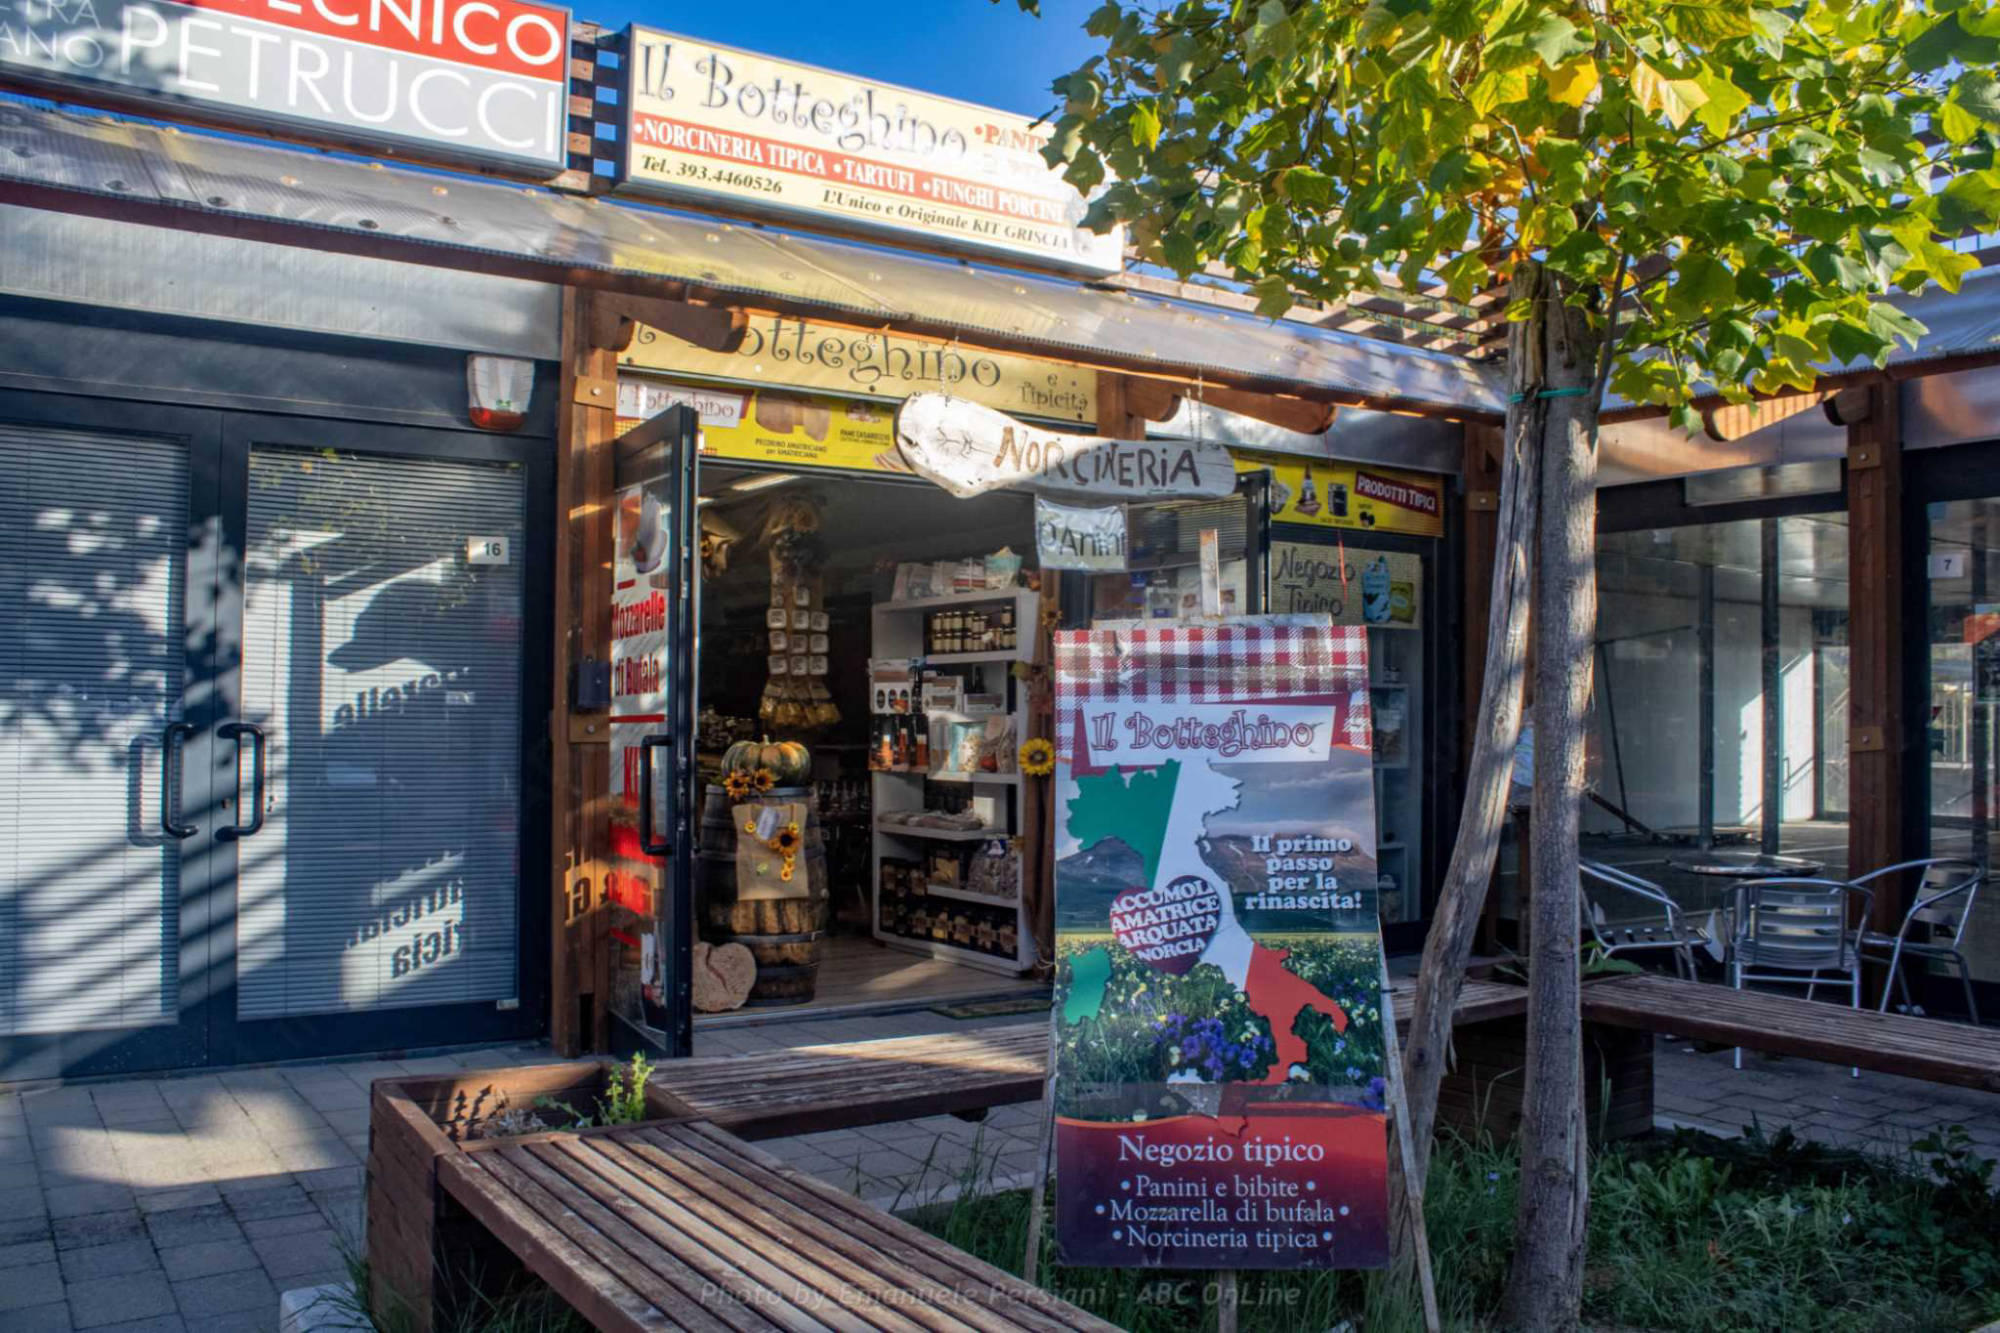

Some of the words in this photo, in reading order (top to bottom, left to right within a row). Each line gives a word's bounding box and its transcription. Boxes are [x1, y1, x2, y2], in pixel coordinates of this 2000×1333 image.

[119, 4, 558, 154] PETRUCCI
[638, 43, 676, 102] Il
[694, 53, 967, 158] Botteghino
[642, 117, 764, 163] NORCINERIA
[767, 143, 827, 175] TIPICA
[843, 159, 916, 193] TARTUFI
[931, 176, 995, 209] FUNGHI
[997, 189, 1066, 223] PORCINI
[642, 155, 671, 175] Tel.
[676, 161, 783, 194] 393.4460526
[898, 204, 968, 229] Originale
[972, 219, 1001, 235] KIT
[689, 318, 1000, 387] otteghino
[1356, 474, 1407, 503] PRODOTTI
[1408, 487, 1436, 512] TIPICI
[482, 542, 502, 557] 16
[1943, 559, 1953, 571] 7
[1091, 711, 1117, 751] Il
[1124, 709, 1315, 757] Botteghino
[1250, 836, 1272, 853] Il
[1275, 836, 1353, 861] primo
[1266, 857, 1335, 877] passo
[1268, 877, 1310, 896] per
[1315, 872, 1339, 890] la
[1112, 894, 1220, 932] AMATRICE
[1245, 892, 1362, 911] rinascita!
[1119, 914, 1218, 949] ARQUATA
[1136, 936, 1206, 962] NORCIA
[1118, 1134, 1233, 1167] Negozio
[1242, 1135, 1325, 1167] tipico
[1135, 1174, 1208, 1198] Panini
[1215, 1182, 1227, 1198] e
[1234, 1174, 1299, 1198] bibite
[1110, 1199, 1228, 1223] Mozzarella
[1237, 1199, 1258, 1223] di
[1265, 1199, 1335, 1223] bufala
[1127, 1225, 1248, 1249] Norcineria
[1255, 1226, 1319, 1252] tipica
